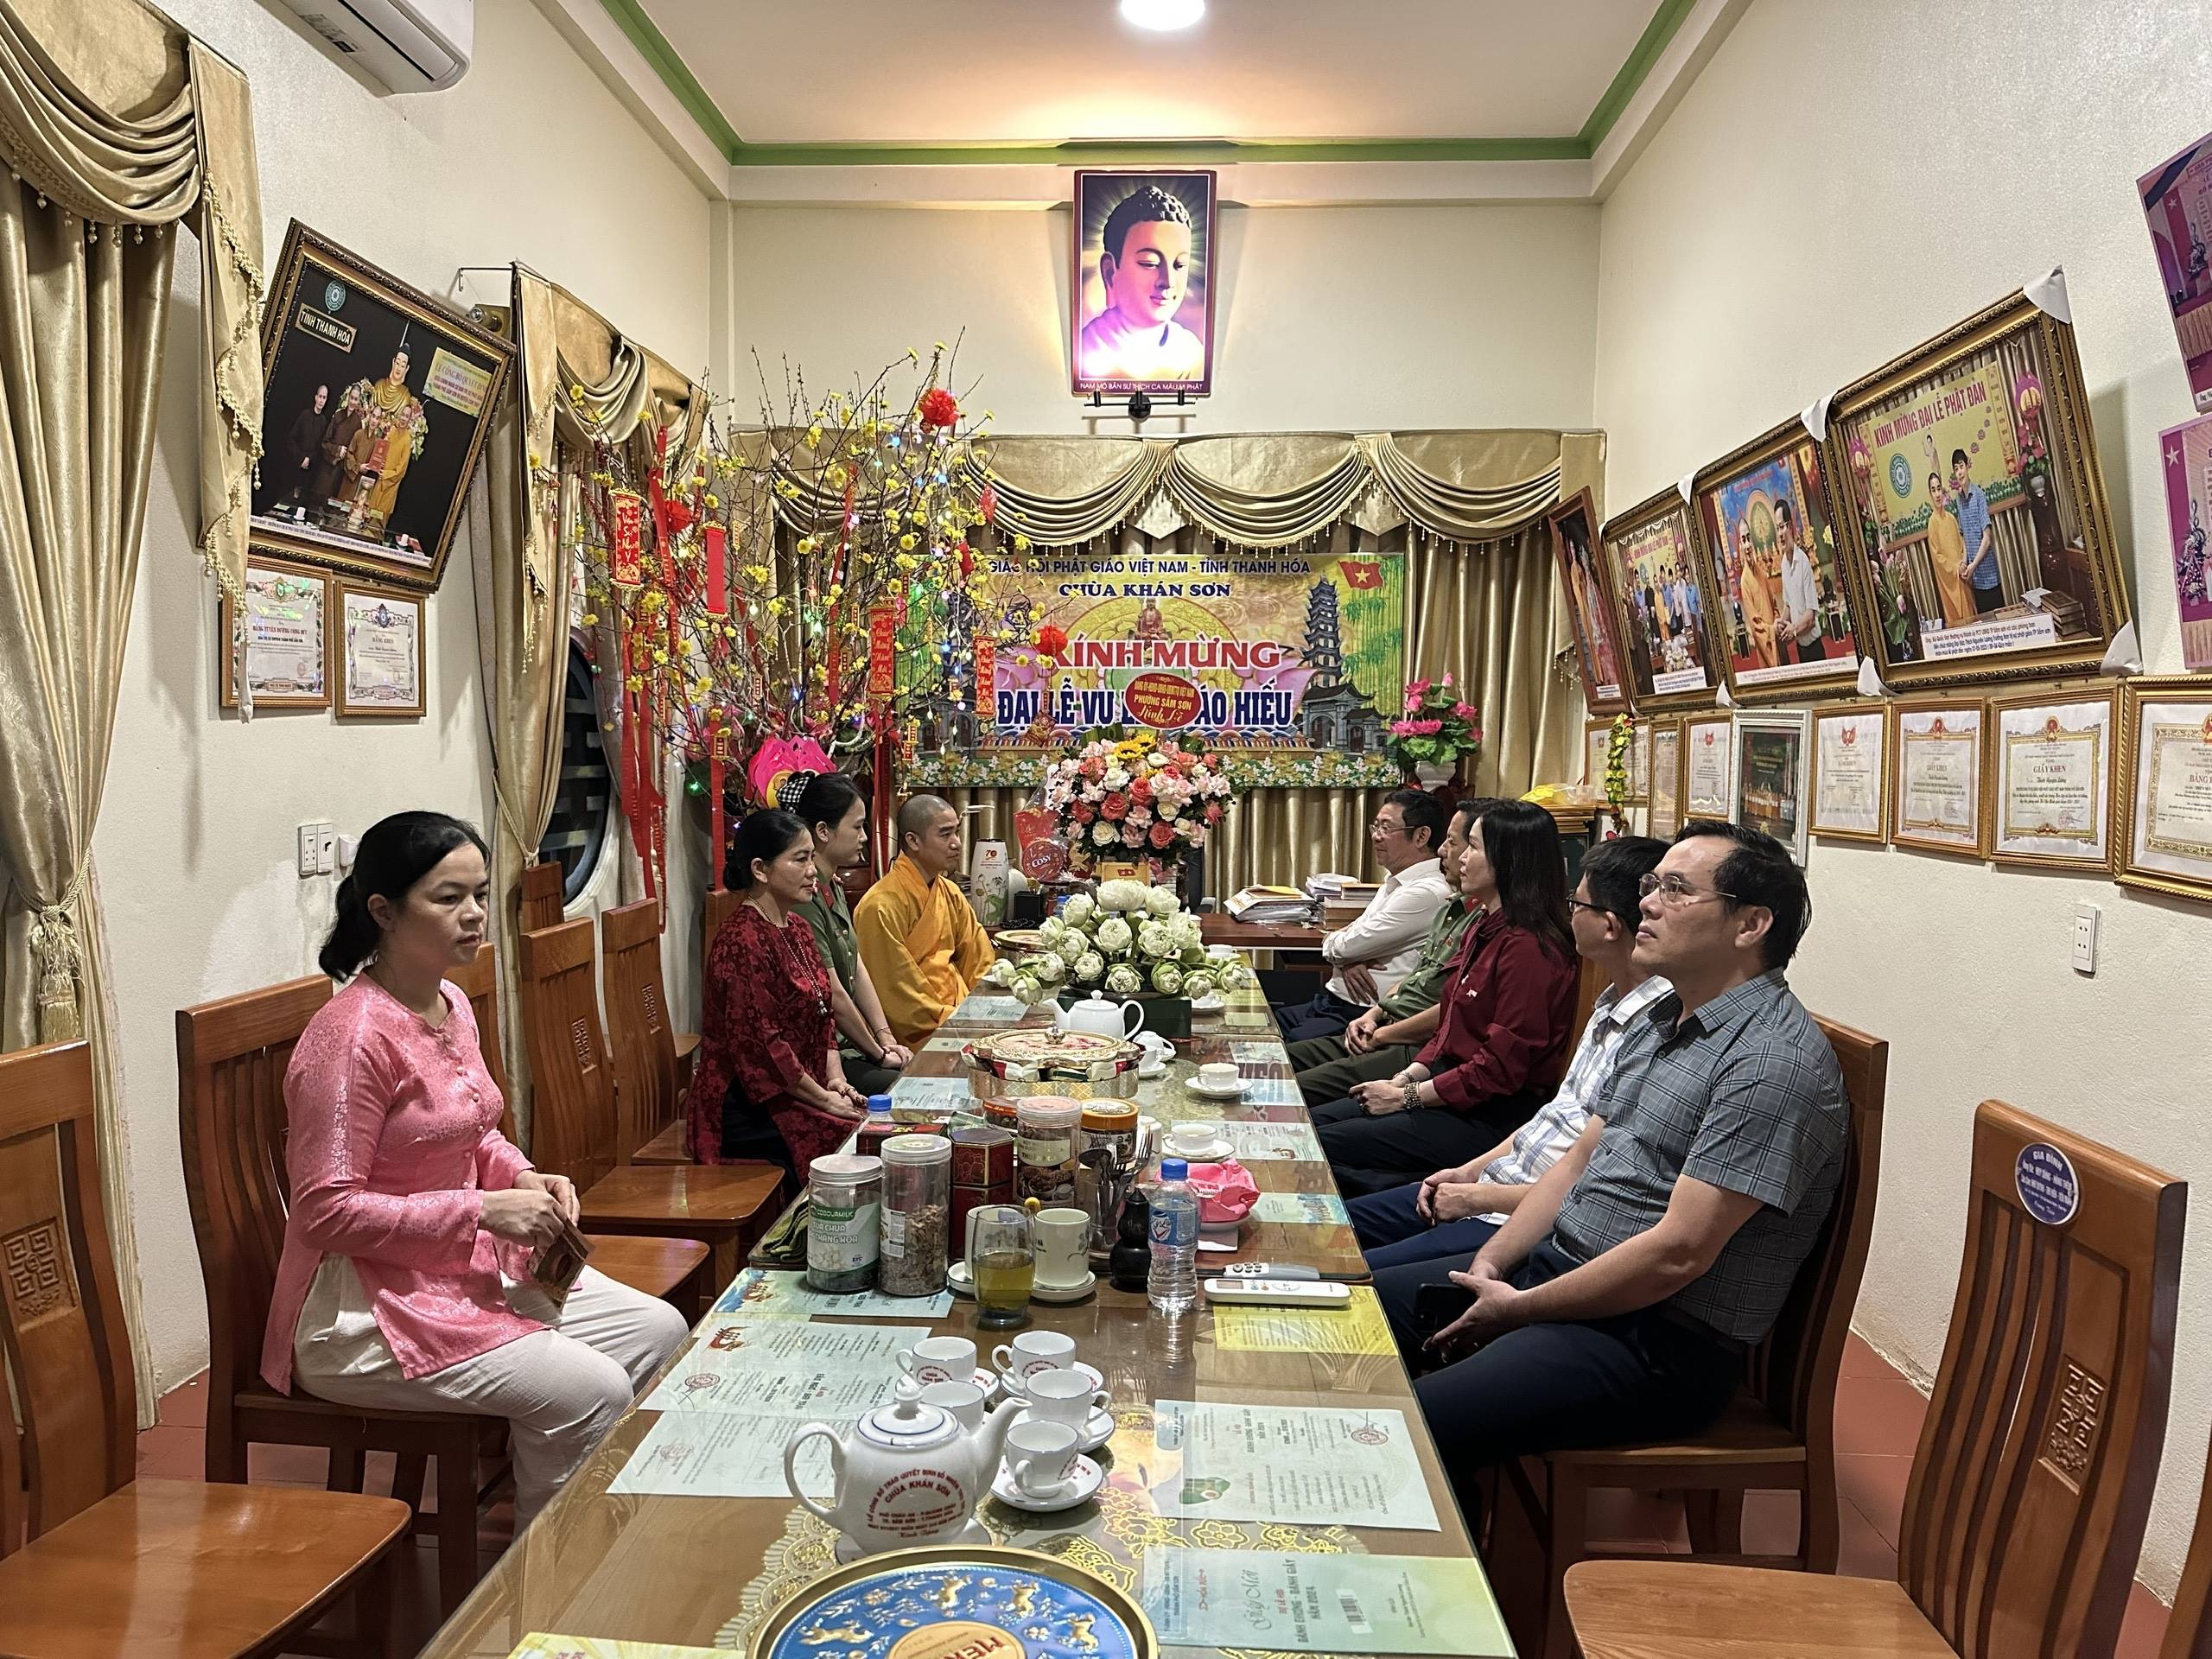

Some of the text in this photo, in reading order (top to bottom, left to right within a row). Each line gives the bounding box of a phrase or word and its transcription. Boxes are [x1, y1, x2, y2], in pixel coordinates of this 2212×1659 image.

[316, 318, 338, 338] THANH
[1874, 423, 1894, 448] KÍNH
[1893, 413, 1918, 440] MỪNG
[1917, 406, 1934, 429] ĐẠI
[1934, 392, 1944, 422] LỄ
[1944, 387, 1967, 416] PHẬT
[1054, 558, 1086, 576] PHẬT
[1090, 558, 1124, 573] GIÁO
[1129, 558, 1155, 576] VIỆT
[1159, 561, 1188, 573] NAM
[1200, 556, 1228, 573] TỈNH
[1233, 561, 1276, 573] THANH
[1281, 558, 1310, 573] HÓA
[1123, 581, 1182, 596] KHÁN
[1189, 582, 1230, 596] SƠN
[1152, 632, 1282, 668] MỪNG
[1081, 690, 1116, 726] VU
[1235, 677, 1293, 726] HIẾU
[1178, 700, 1192, 710] SƠN
[1032, 854, 1052, 868] COSY
[900, 1467, 920, 1479] QUYẾT
[885, 1478, 951, 1503] CHÙA KHÁN SƠN
